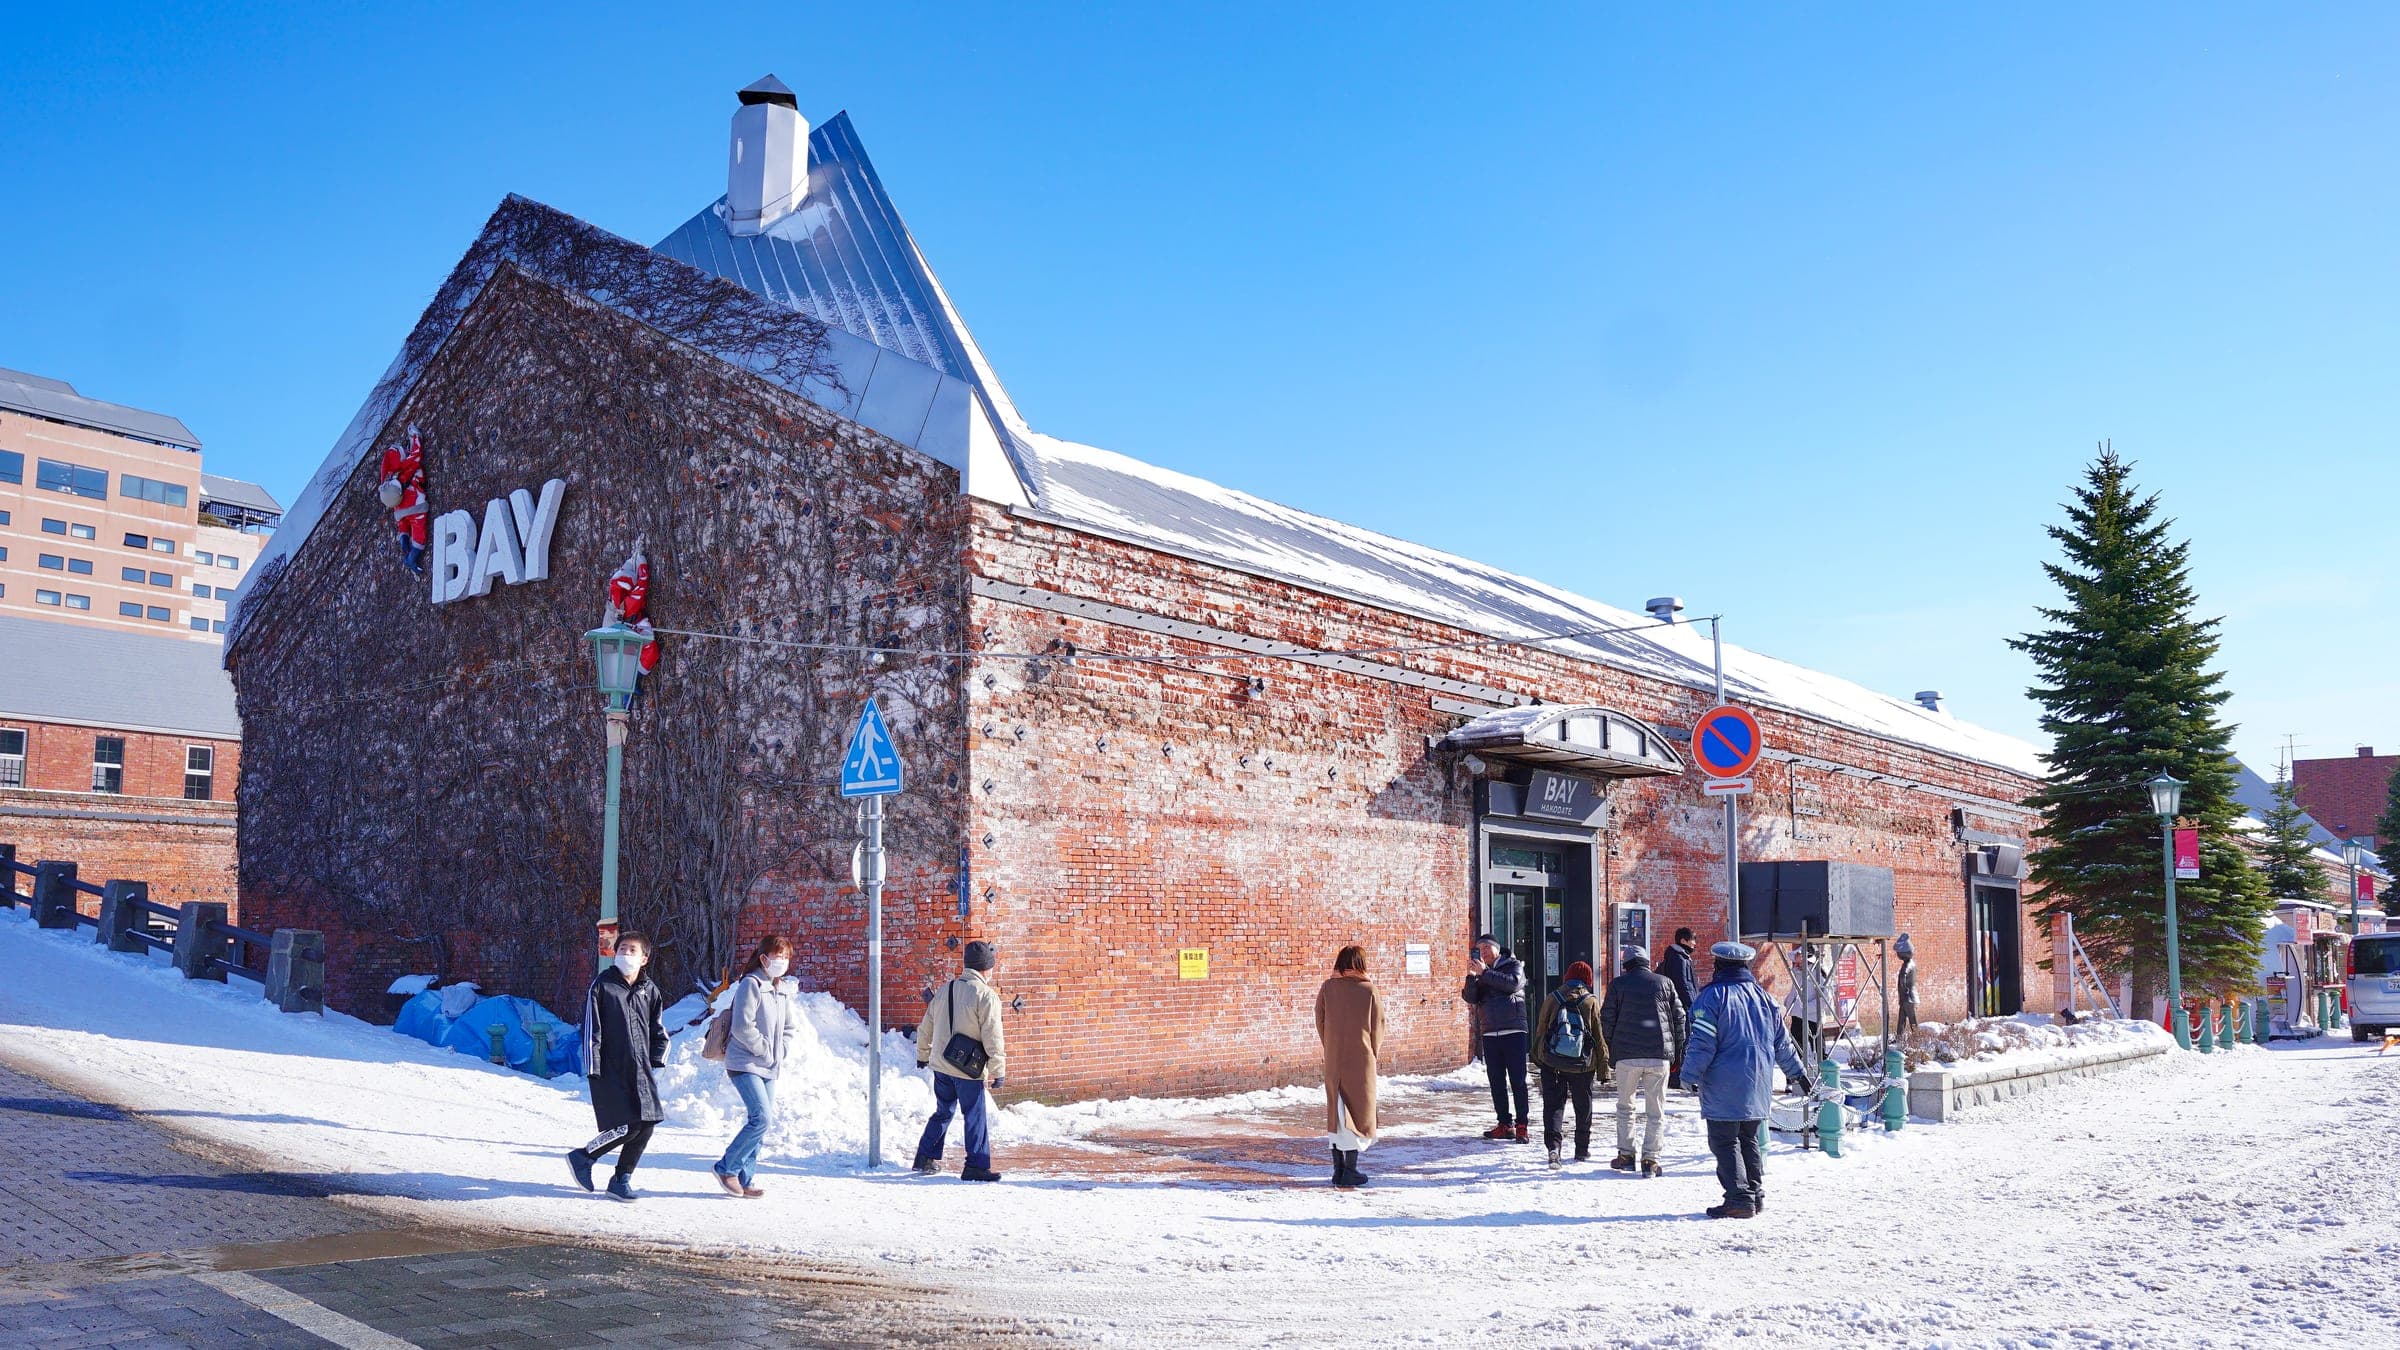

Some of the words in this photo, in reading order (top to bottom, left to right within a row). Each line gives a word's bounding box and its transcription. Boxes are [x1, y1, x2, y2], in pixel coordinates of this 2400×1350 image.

[432, 479, 566, 603] BAY
[1544, 777, 1578, 804] BAY
[1541, 803, 1572, 816] HAKODATE
